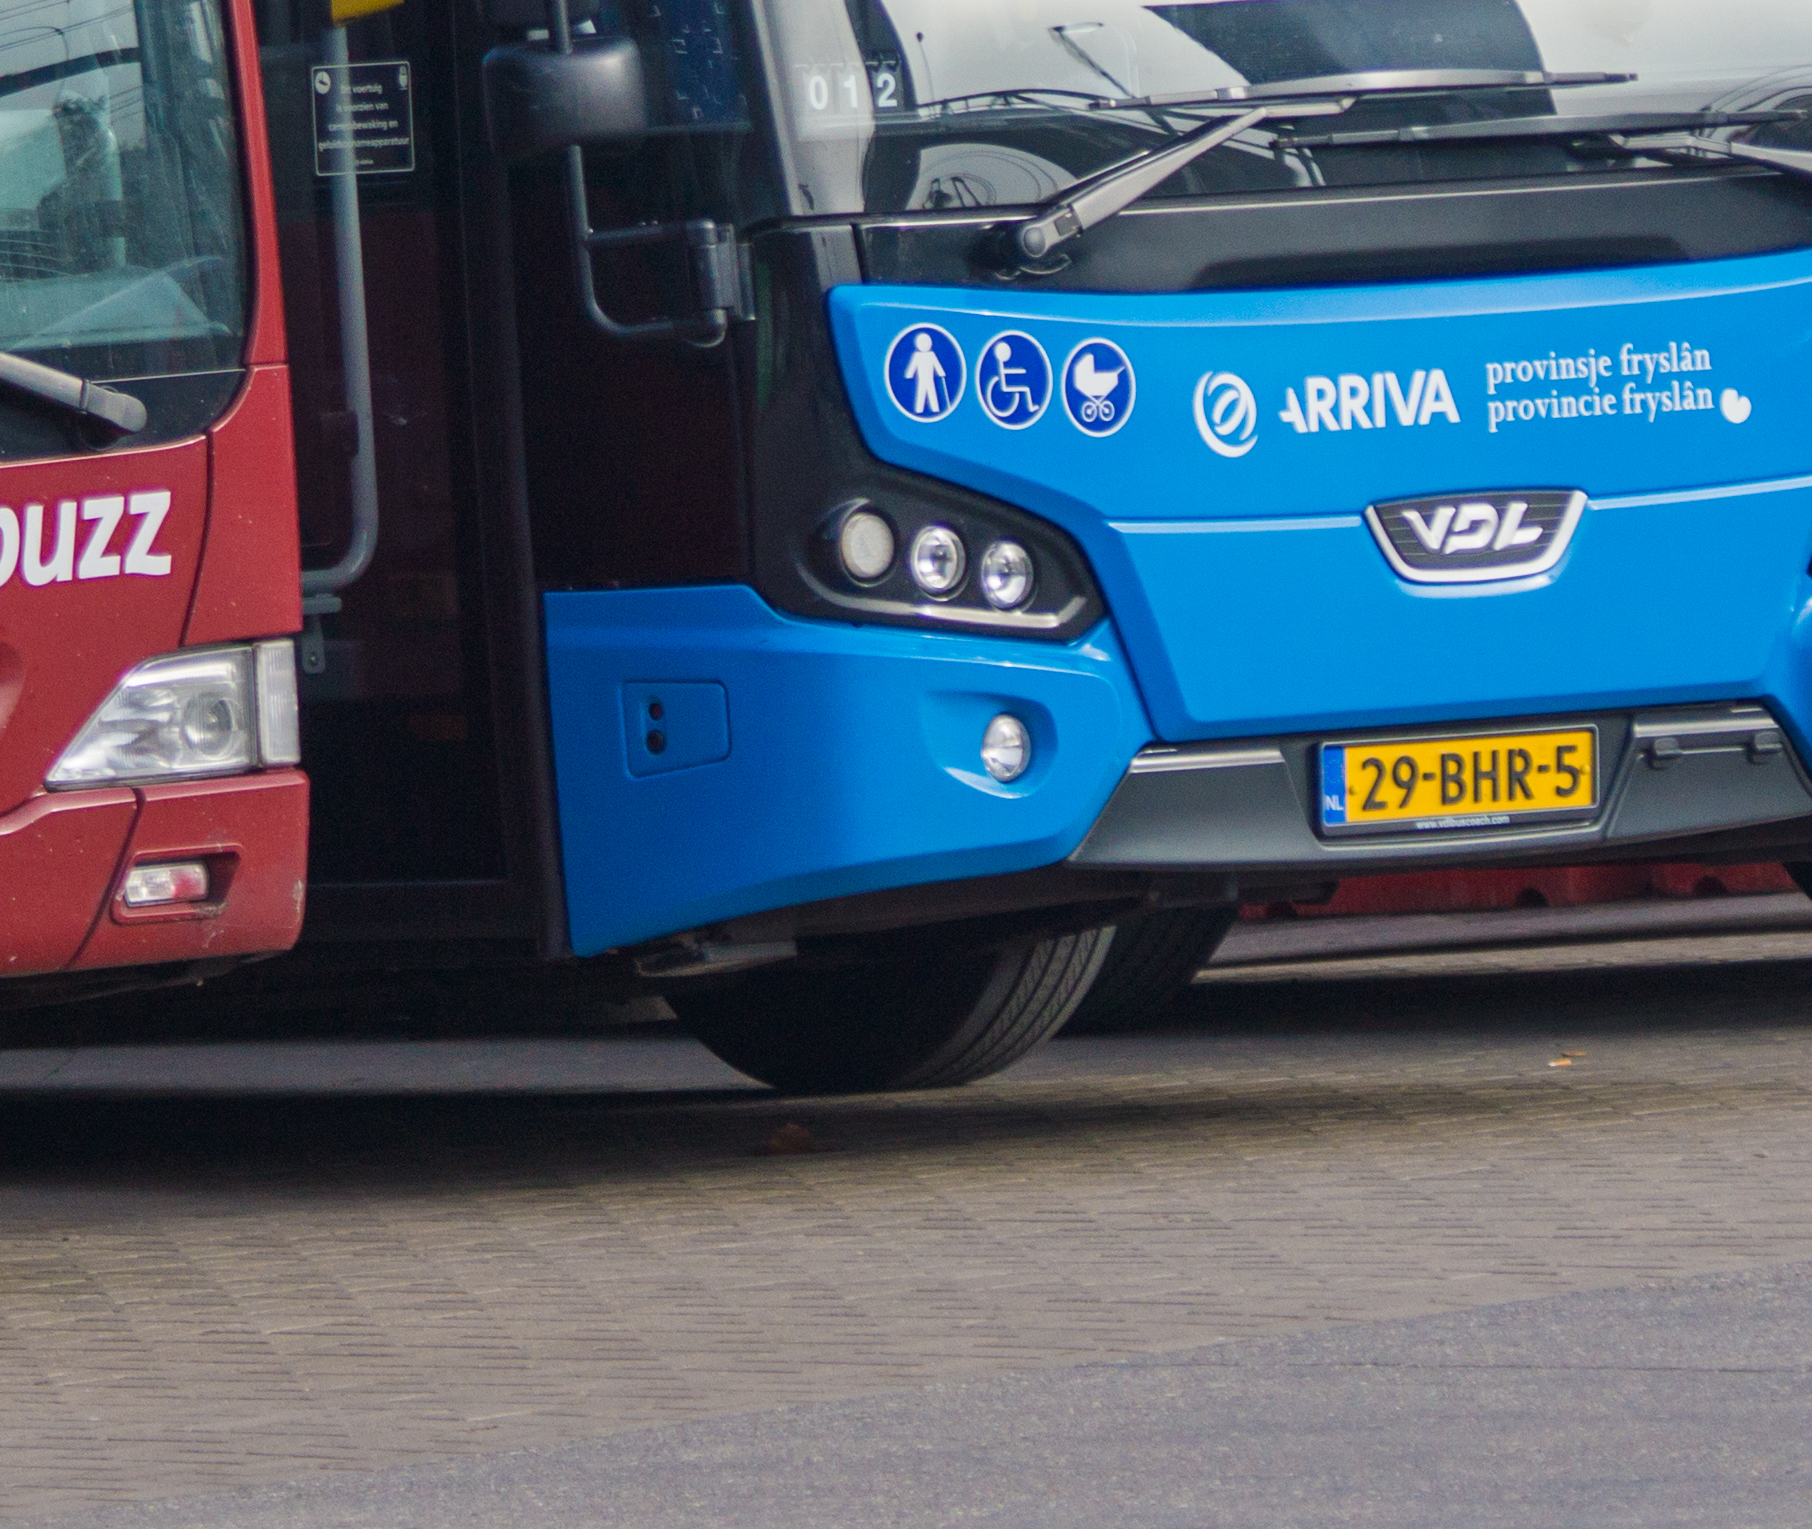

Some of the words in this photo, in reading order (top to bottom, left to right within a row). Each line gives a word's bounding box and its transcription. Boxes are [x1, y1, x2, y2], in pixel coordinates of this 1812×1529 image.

[808, 72, 898, 111] 012
[1486, 348, 1612, 395] provinsje
[1619, 341, 1712, 384] fryslân
[1278, 368, 1461, 434] ARRIVA
[1487, 387, 1617, 434] provincie
[1622, 380, 1715, 423] fryslân
[1400, 501, 1544, 554] VDL
[1325, 795, 1345, 811] NL
[1361, 744, 1582, 812] 29-BHR-5
